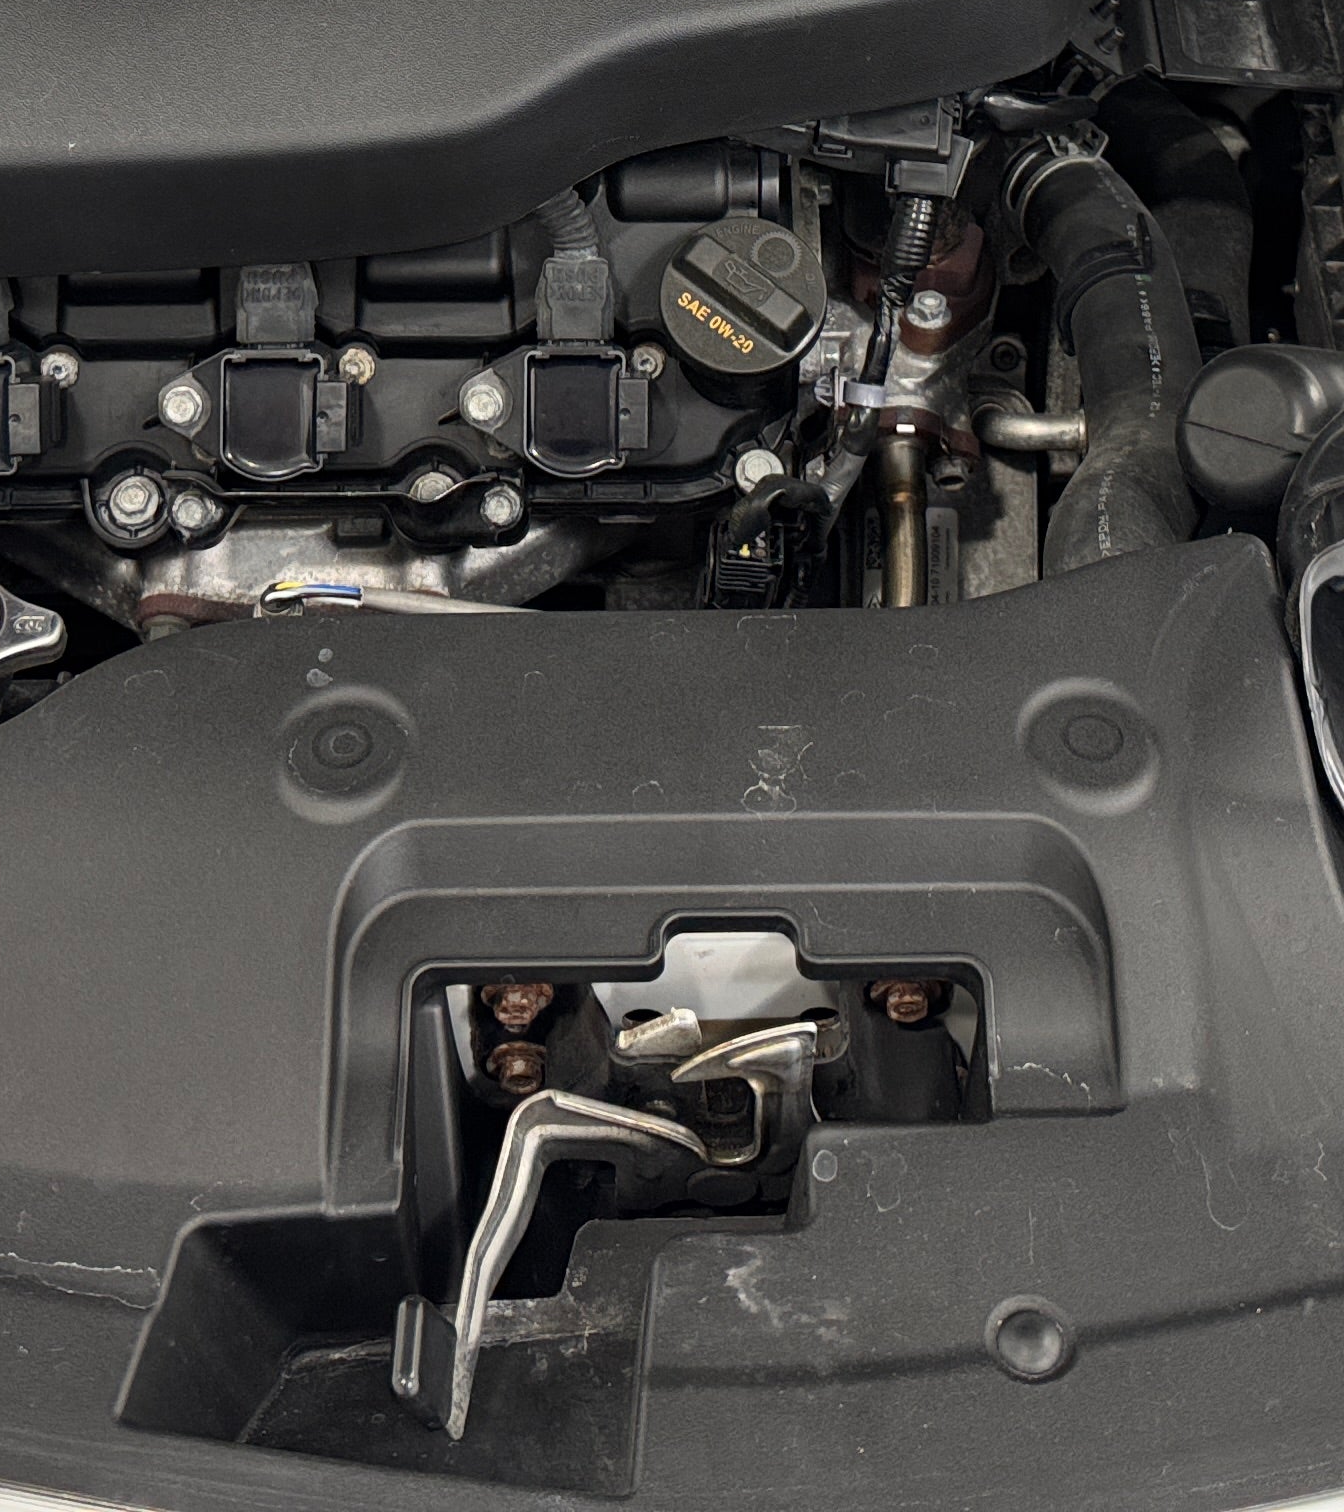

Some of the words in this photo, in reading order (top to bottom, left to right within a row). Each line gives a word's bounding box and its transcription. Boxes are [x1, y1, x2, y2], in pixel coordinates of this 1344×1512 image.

[715, 224, 761, 237] ENGINE
[677, 291, 712, 322] SAE
[708, 315, 755, 355] 0W-20
